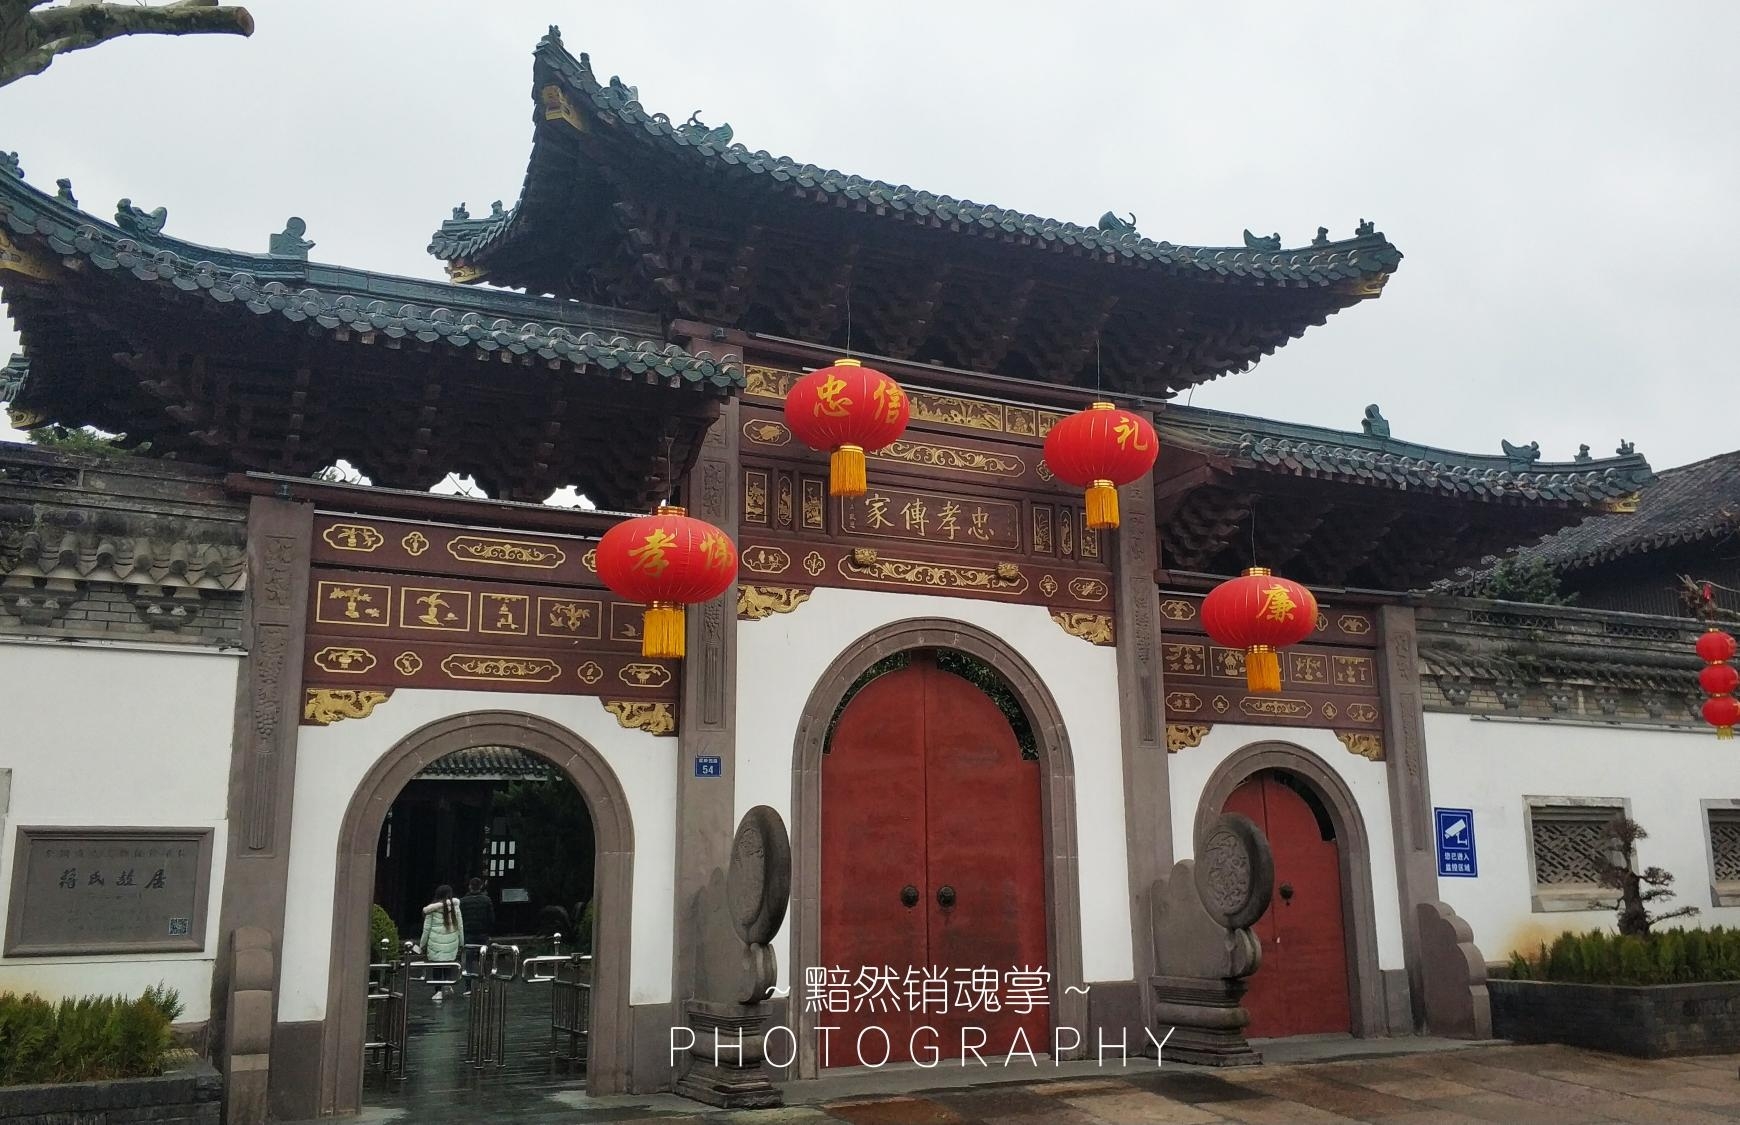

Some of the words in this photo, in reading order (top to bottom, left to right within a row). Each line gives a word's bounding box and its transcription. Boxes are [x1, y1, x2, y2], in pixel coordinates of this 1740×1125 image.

[1113, 417, 1149, 451] 礼
[1256, 584, 1298, 624] 廉
[702, 765, 714, 775] 54
